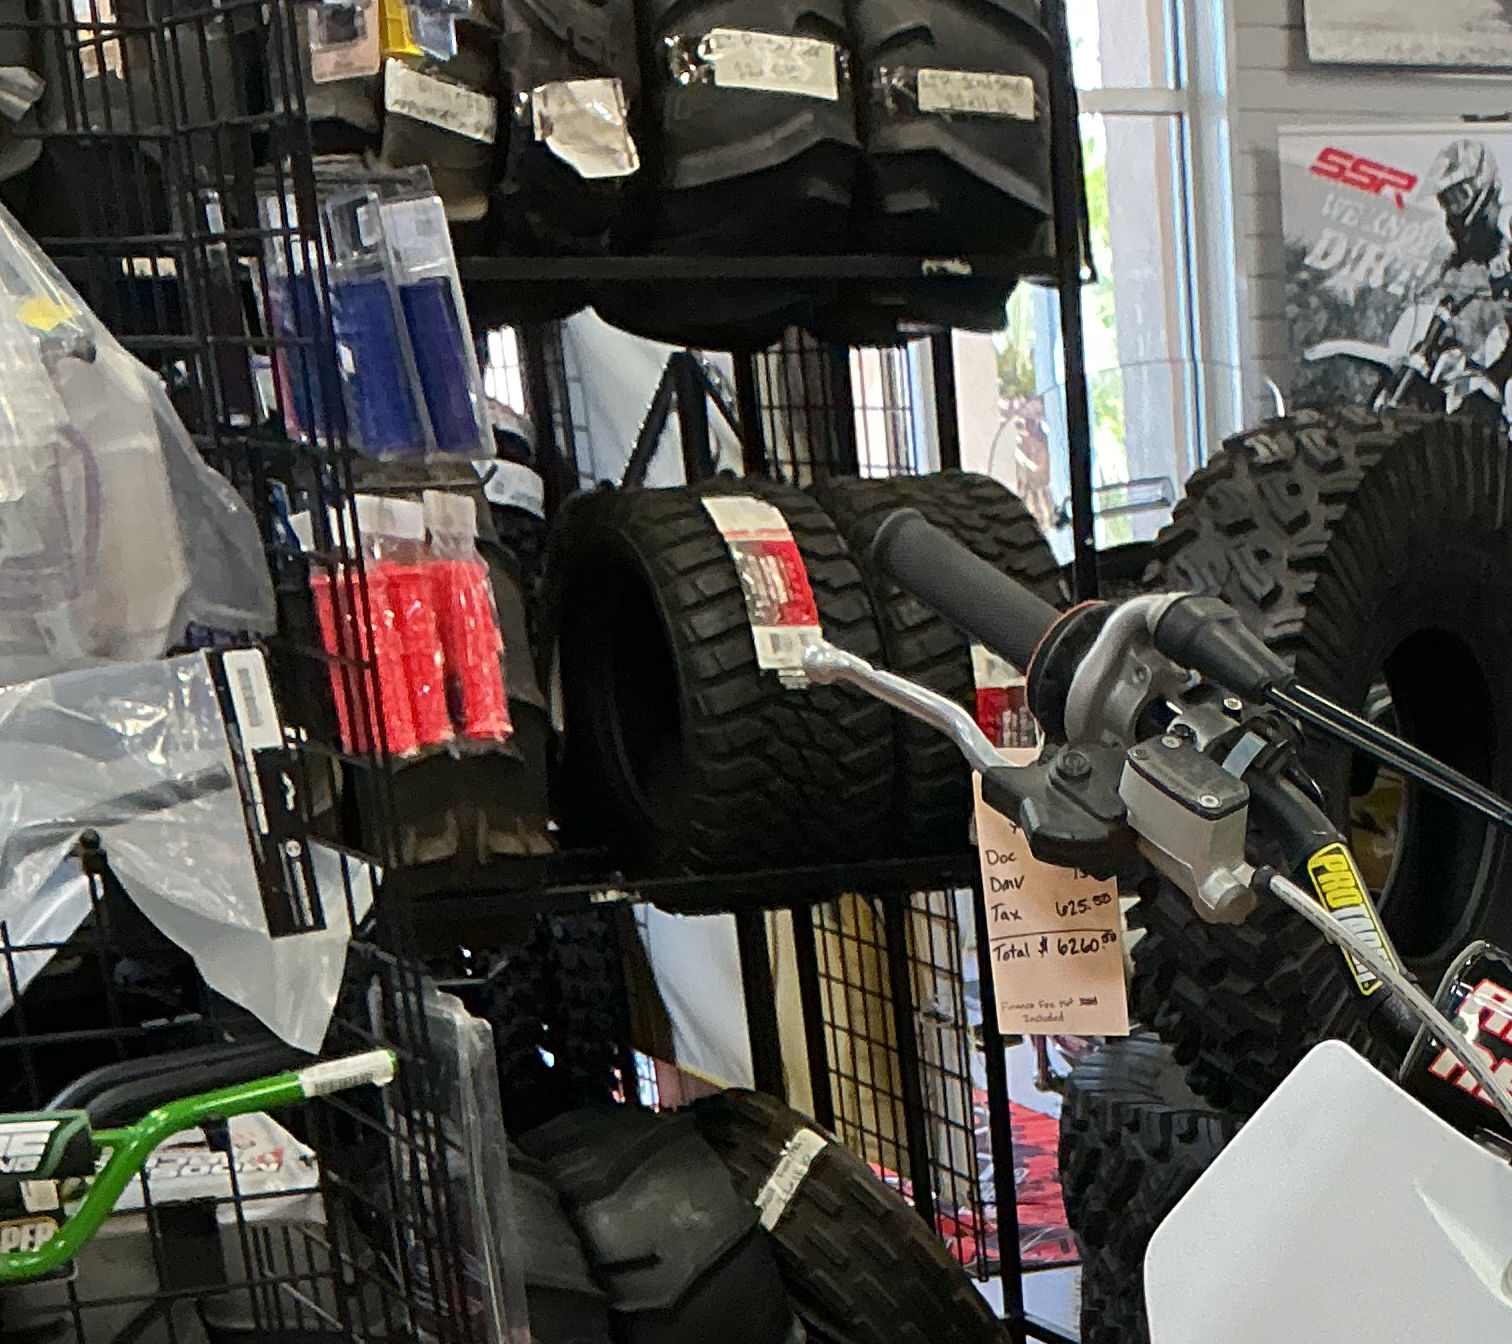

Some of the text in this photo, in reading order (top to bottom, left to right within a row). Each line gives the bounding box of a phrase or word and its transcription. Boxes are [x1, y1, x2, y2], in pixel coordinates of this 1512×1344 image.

[1309, 147, 1419, 211] SSR
[986, 849, 1017, 866] Doc
[991, 903, 1023, 922] Tax
[994, 942, 1031, 962] Total
